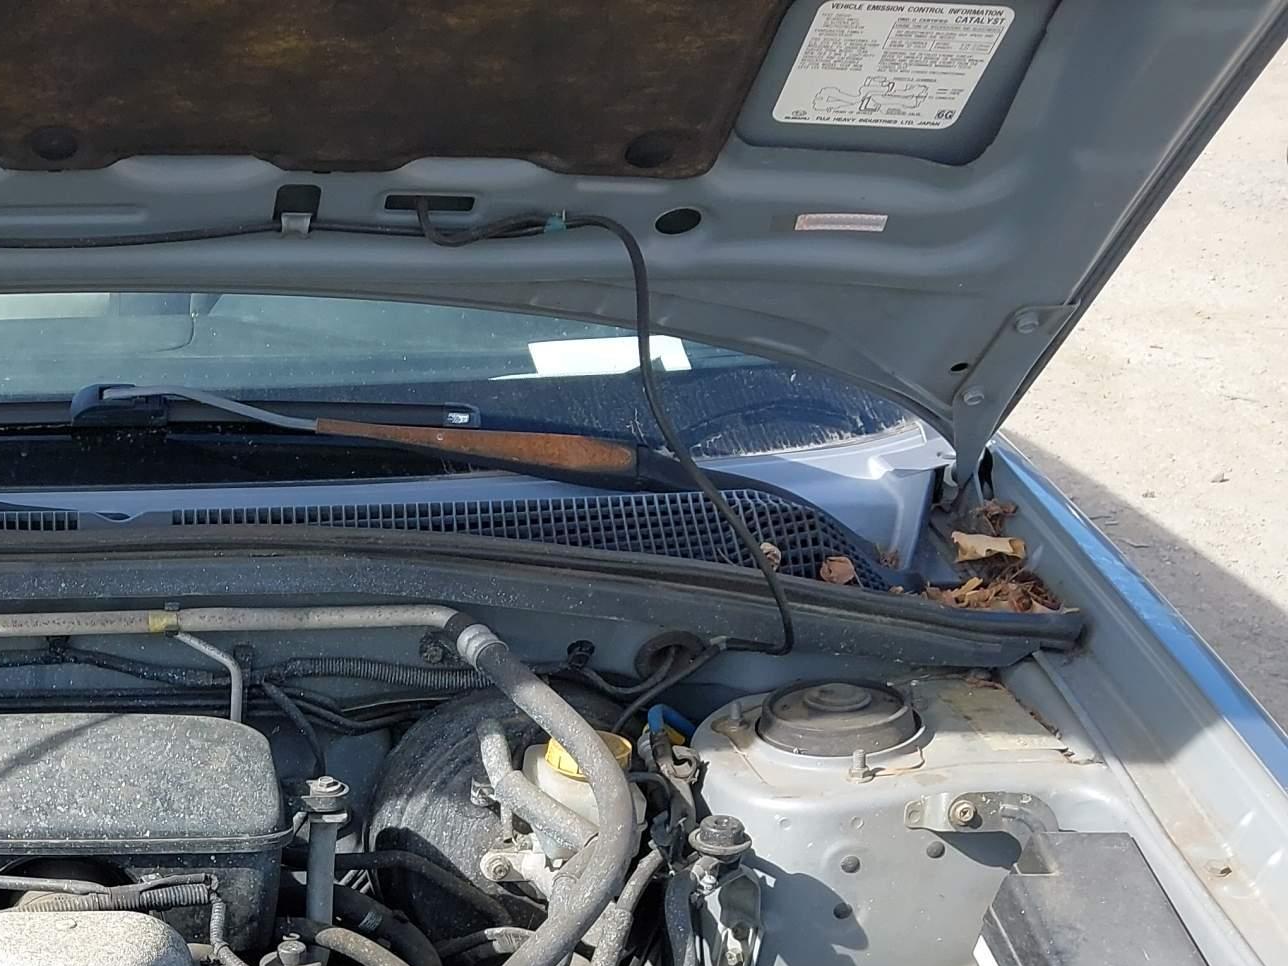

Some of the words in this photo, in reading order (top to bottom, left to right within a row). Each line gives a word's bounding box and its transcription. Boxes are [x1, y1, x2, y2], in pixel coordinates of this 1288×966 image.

[866, 4, 905, 12] EMISSION
[907, 6, 945, 14] CONTROL
[948, 8, 1004, 16] INFORMATION
[954, 16, 1006, 25] CATALYST
